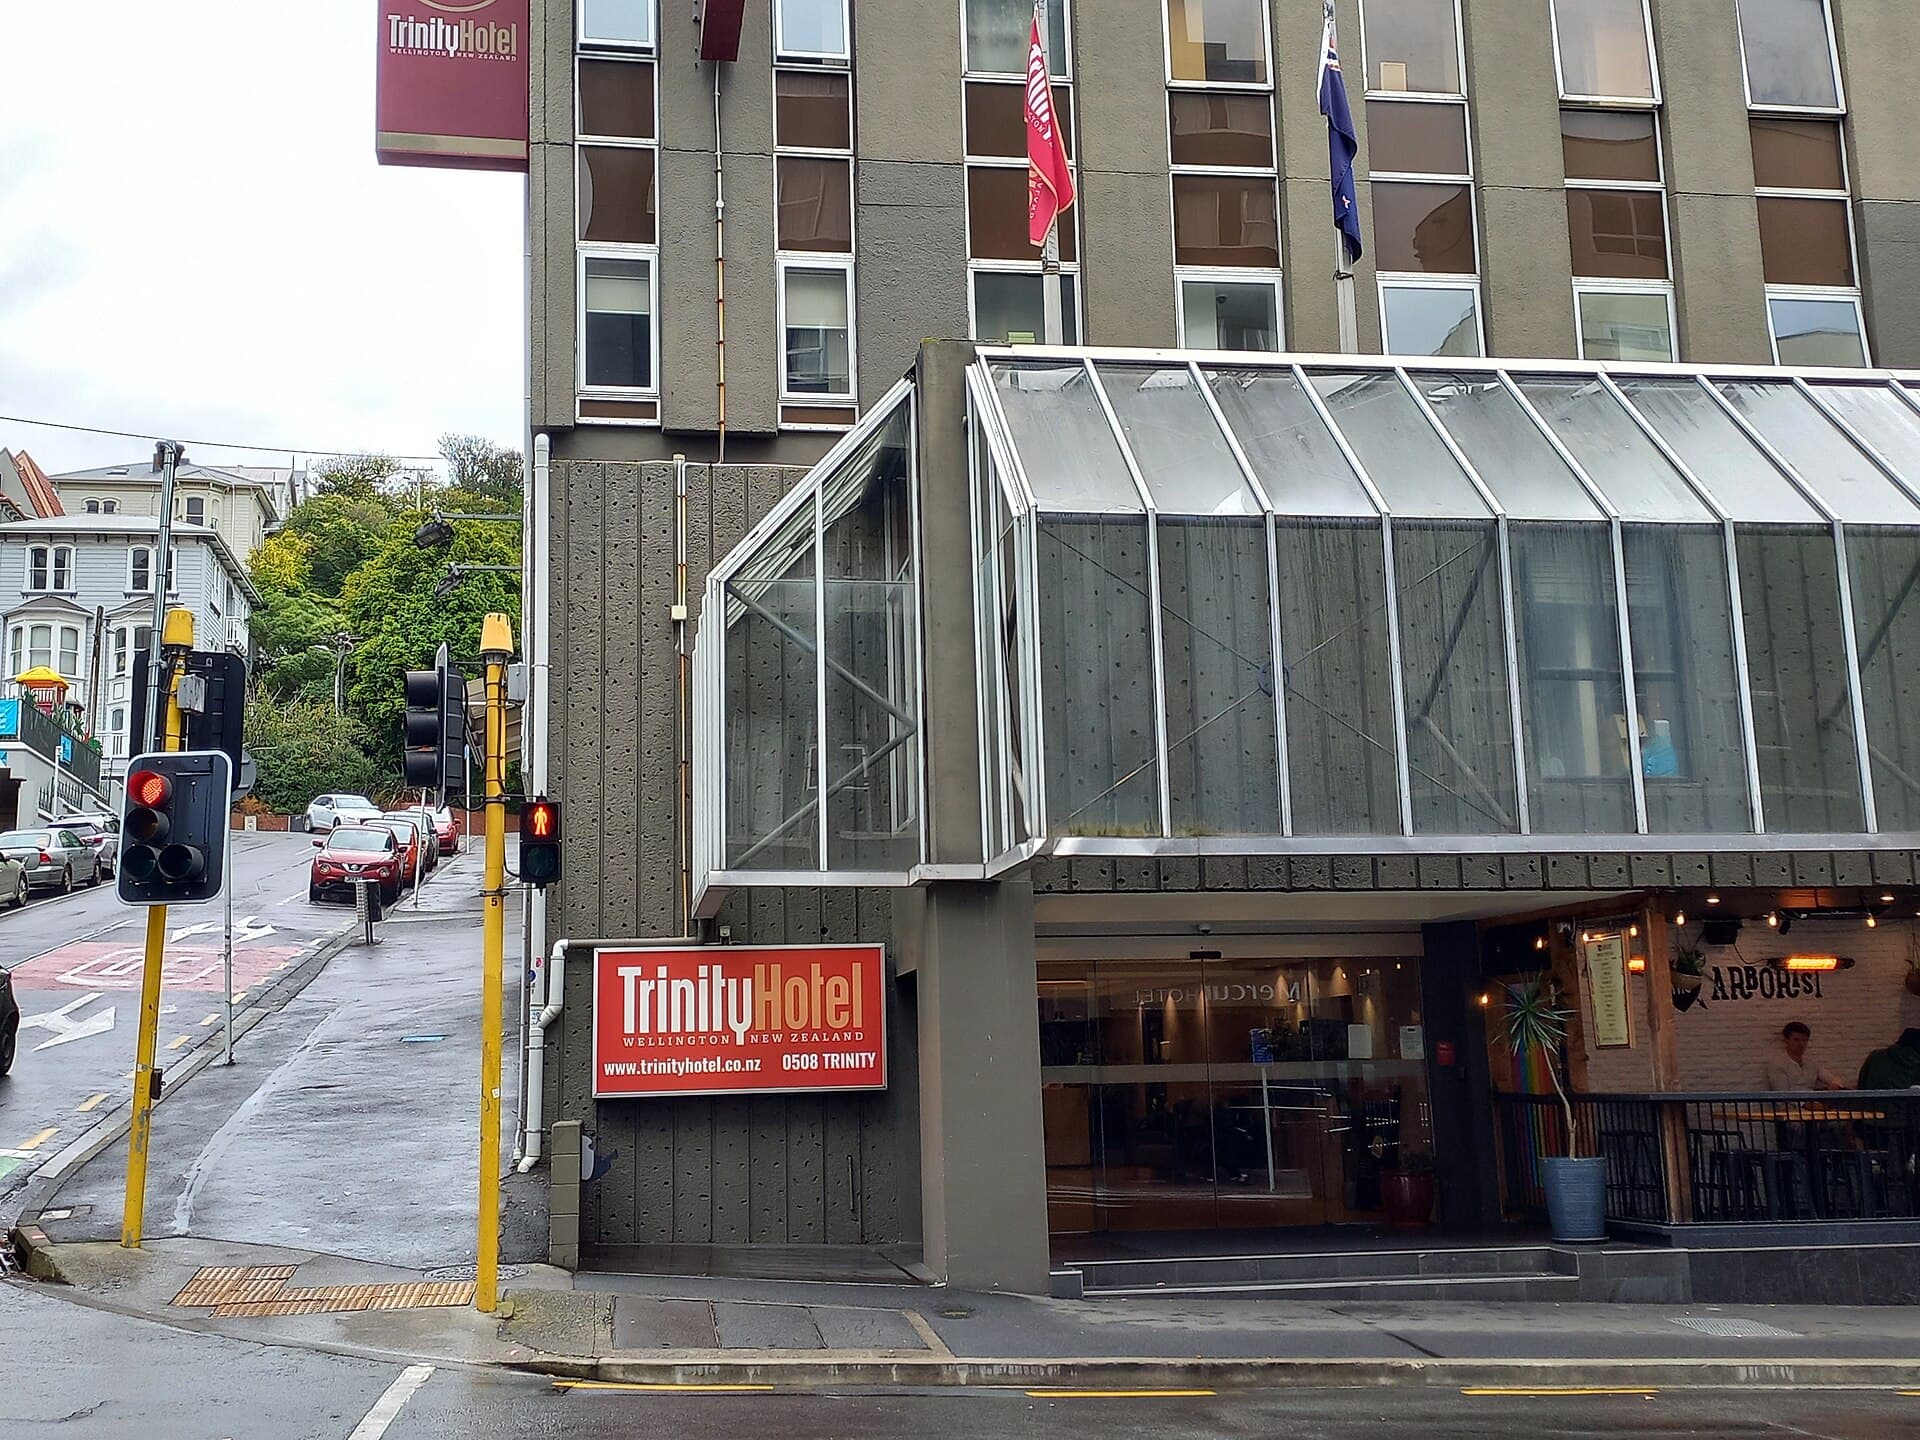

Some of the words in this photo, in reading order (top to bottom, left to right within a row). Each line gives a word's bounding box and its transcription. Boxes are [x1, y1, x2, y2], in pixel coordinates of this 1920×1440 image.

[390, 48, 447, 57] WELLINGTON
[456, 51, 475, 59] NEW
[478, 53, 518, 62] ZEALAND
[622, 1034, 730, 1047] WELLINGTON
[749, 1032, 784, 1044] NEW
[790, 1031, 865, 1043] ZEALAND
[604, 1055, 761, 1077] www.trinityhotel.co.nz
[782, 1053, 819, 1071] 0508
[822, 1051, 876, 1070] TRINITY
